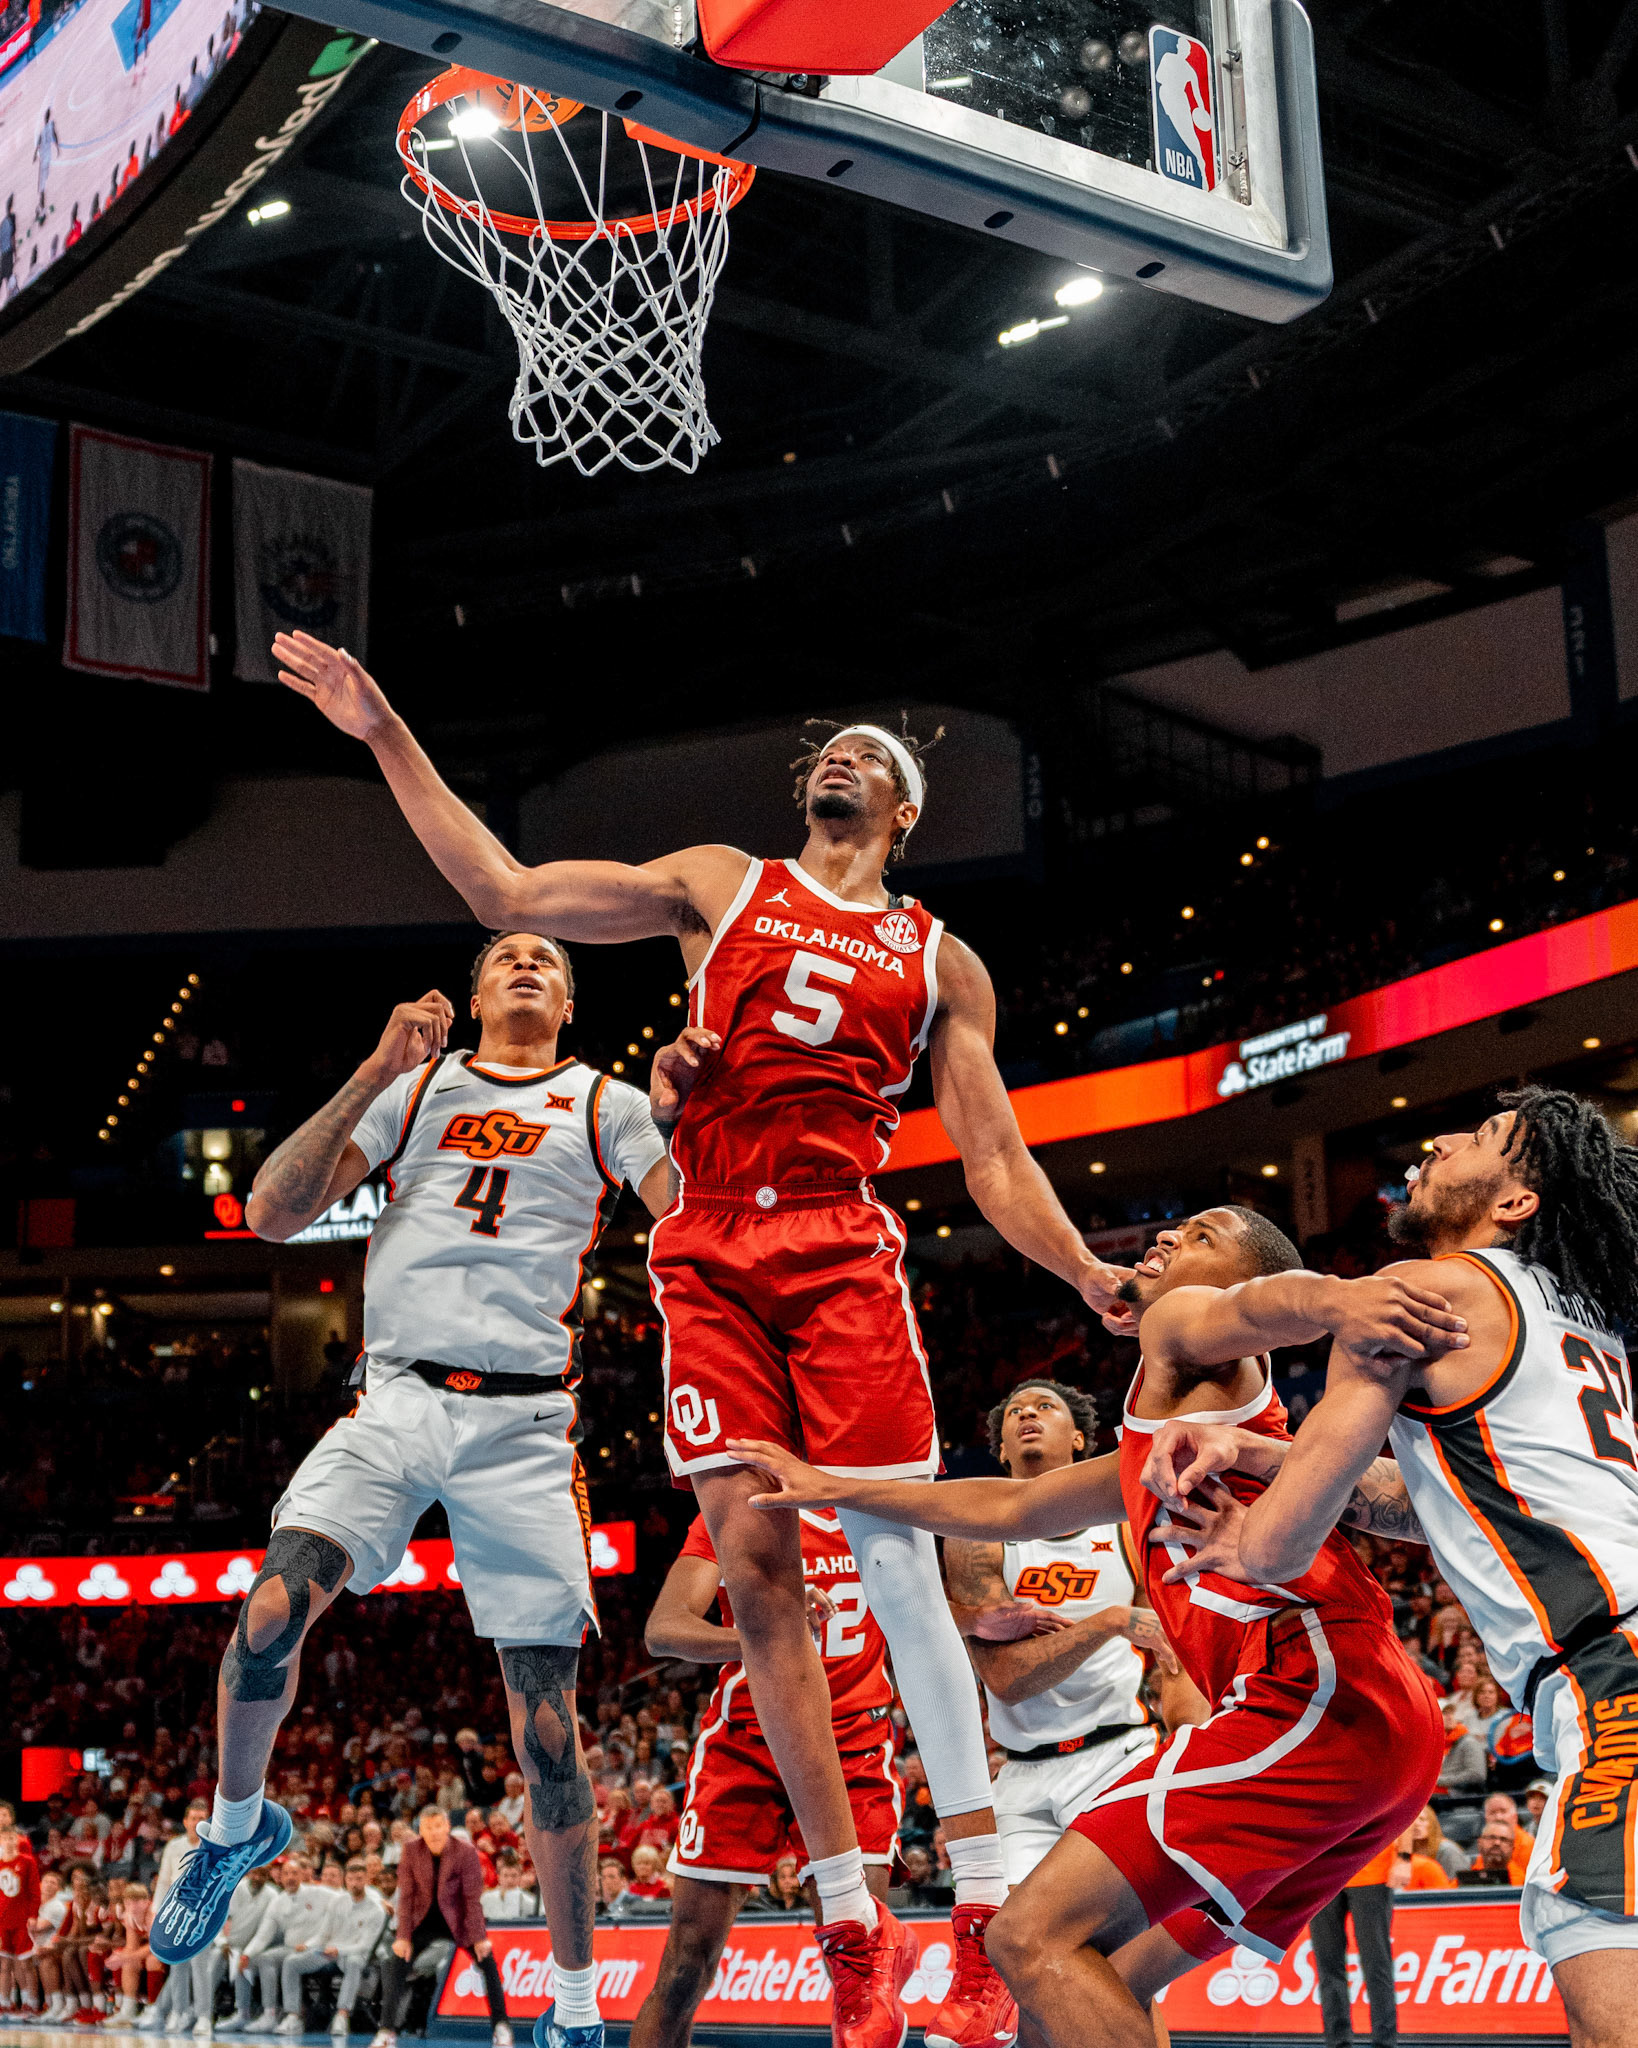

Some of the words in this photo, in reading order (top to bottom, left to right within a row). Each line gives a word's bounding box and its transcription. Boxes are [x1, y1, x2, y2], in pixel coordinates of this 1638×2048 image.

[1165, 147, 1195, 181] NBA
[754, 916, 905, 979] OKLAHOMA
[885, 915, 915, 944] SEC
[771, 950, 857, 1046] 5
[438, 1110, 551, 1161] OSU
[454, 1166, 510, 1238] 4
[446, 1371, 482, 1391] OSU
[670, 1384, 721, 1446] OU
[802, 1555, 857, 1576] LAHO
[1014, 1562, 1100, 1607] OSU
[805, 1582, 868, 1657] 2
[1058, 1736, 1084, 1753] OSU
[679, 1809, 705, 1860] OU
